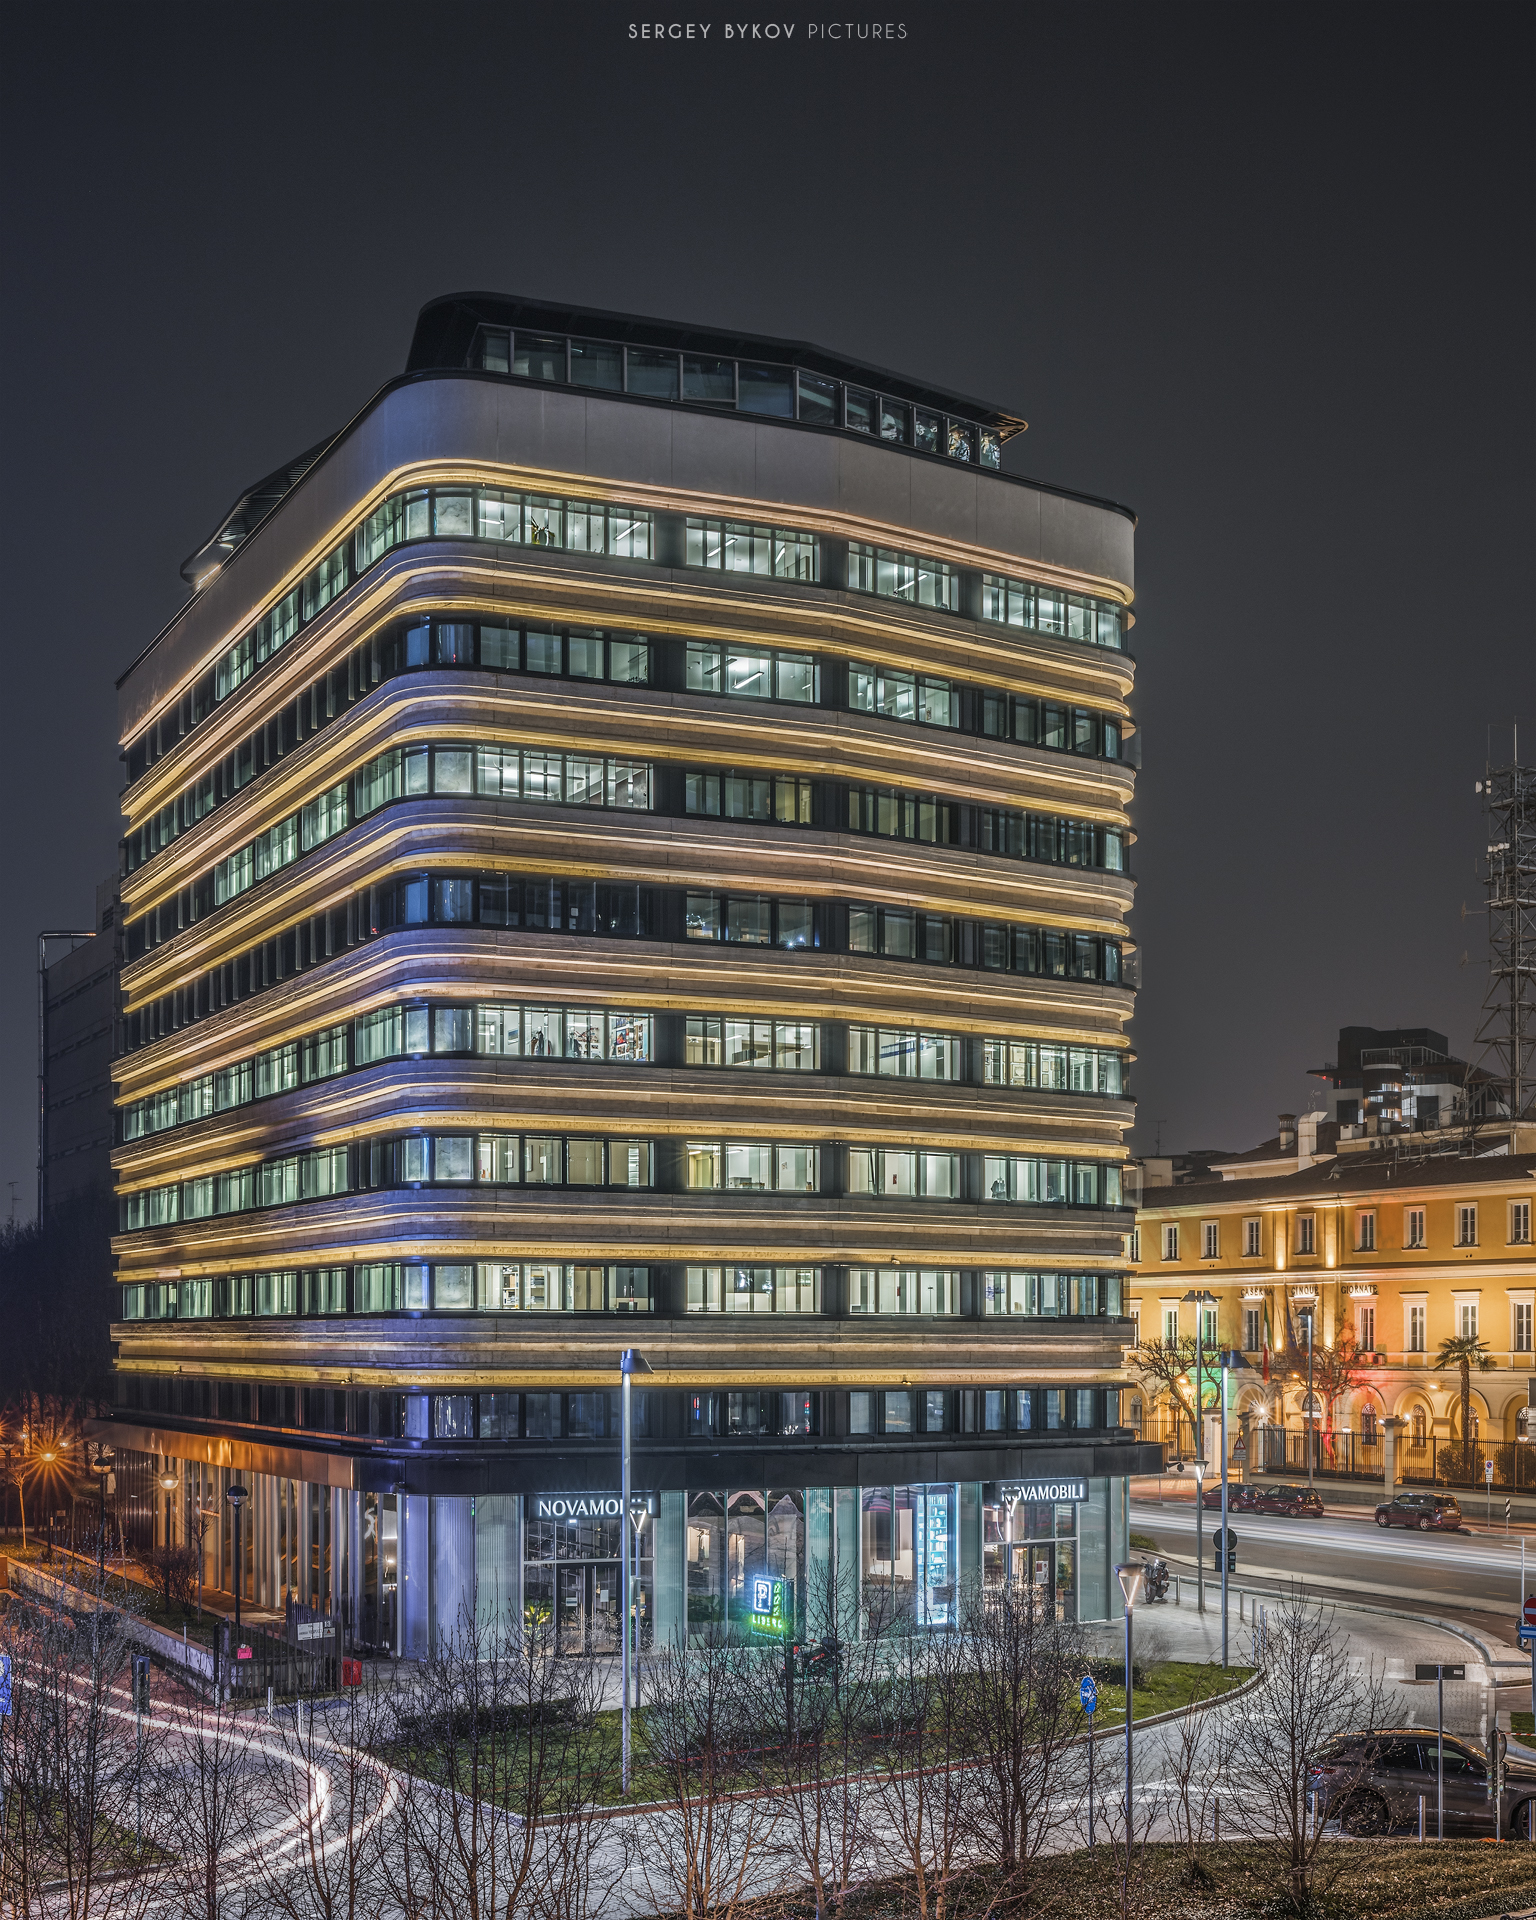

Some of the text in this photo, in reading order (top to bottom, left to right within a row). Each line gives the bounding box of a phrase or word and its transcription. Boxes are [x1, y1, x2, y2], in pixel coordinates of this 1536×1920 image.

[1240, 1284, 1379, 1297] CASERMA CINQUE GIORNATE
